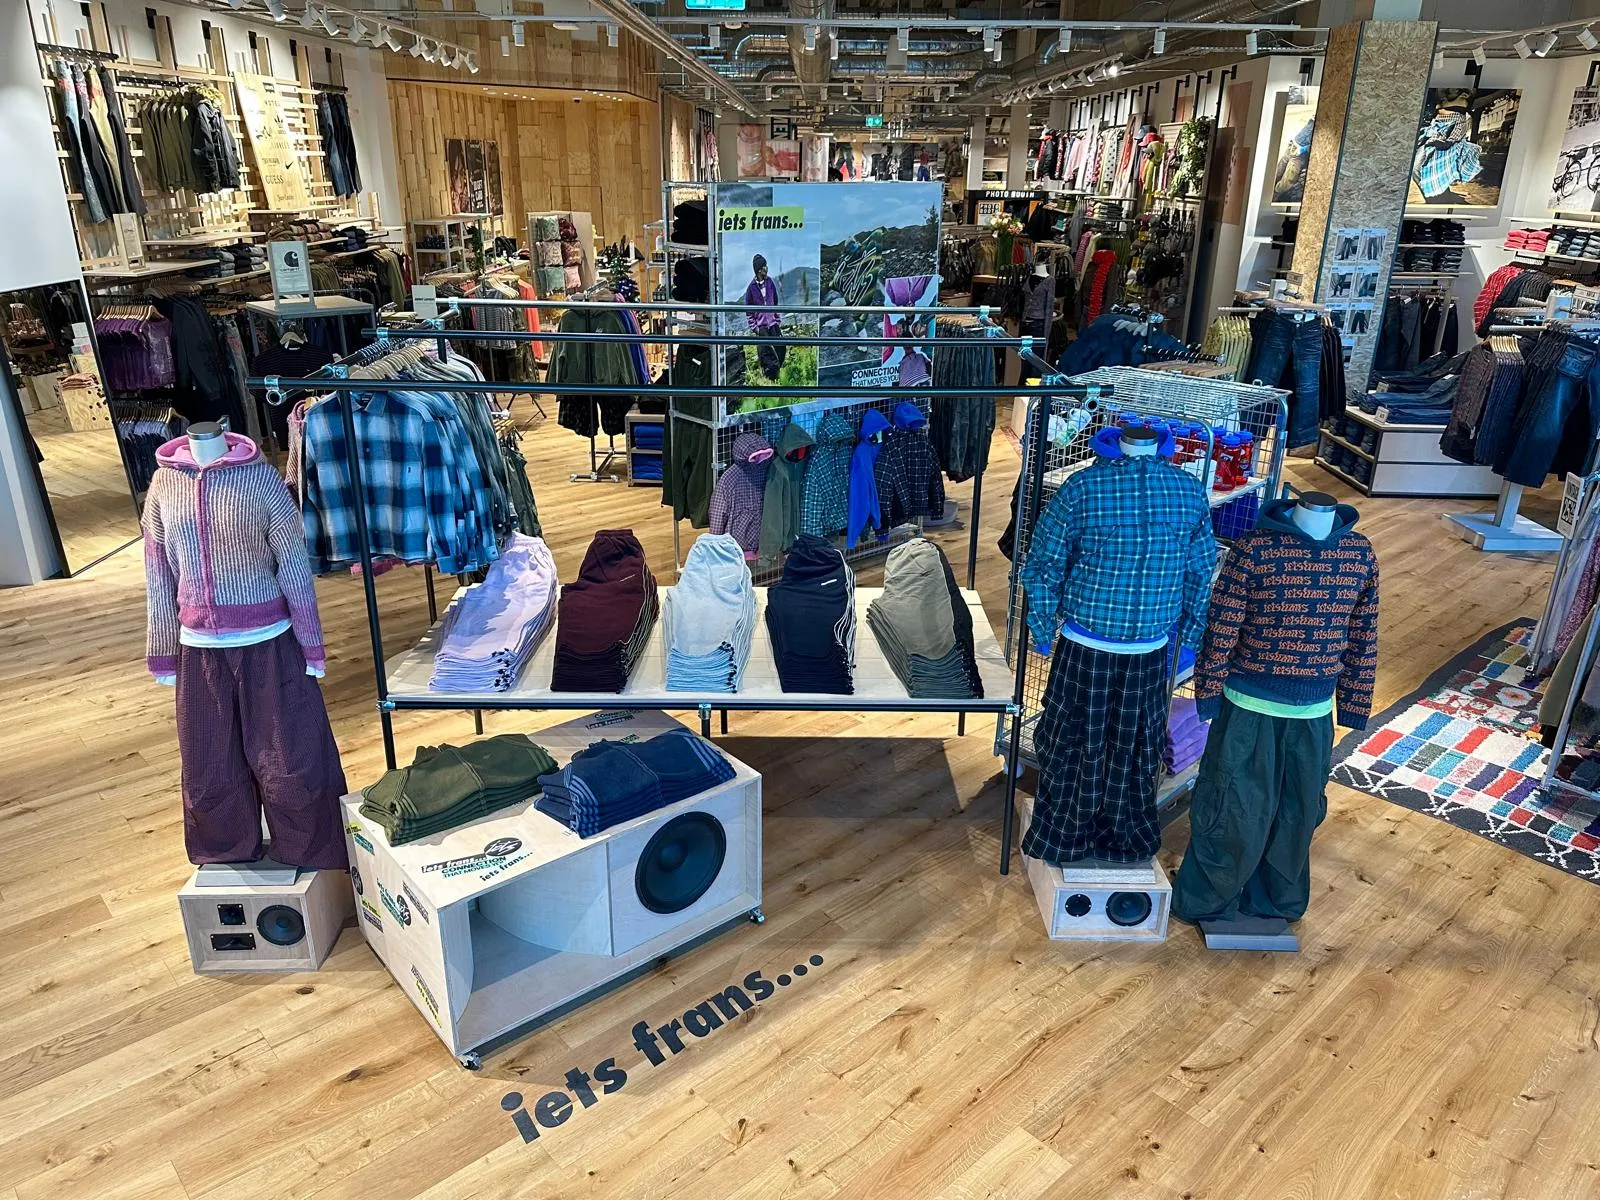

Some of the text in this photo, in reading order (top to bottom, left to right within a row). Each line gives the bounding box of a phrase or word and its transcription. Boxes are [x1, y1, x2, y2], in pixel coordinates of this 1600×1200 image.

[985, 190, 1009, 198] PHOTO
[718, 209, 803, 231] iets frans...
[851, 365, 899, 380] CONNECTION
[441, 856, 506, 874] CONNECTION
[479, 869, 499, 881] iets
[500, 954, 824, 1145] iets frans...
